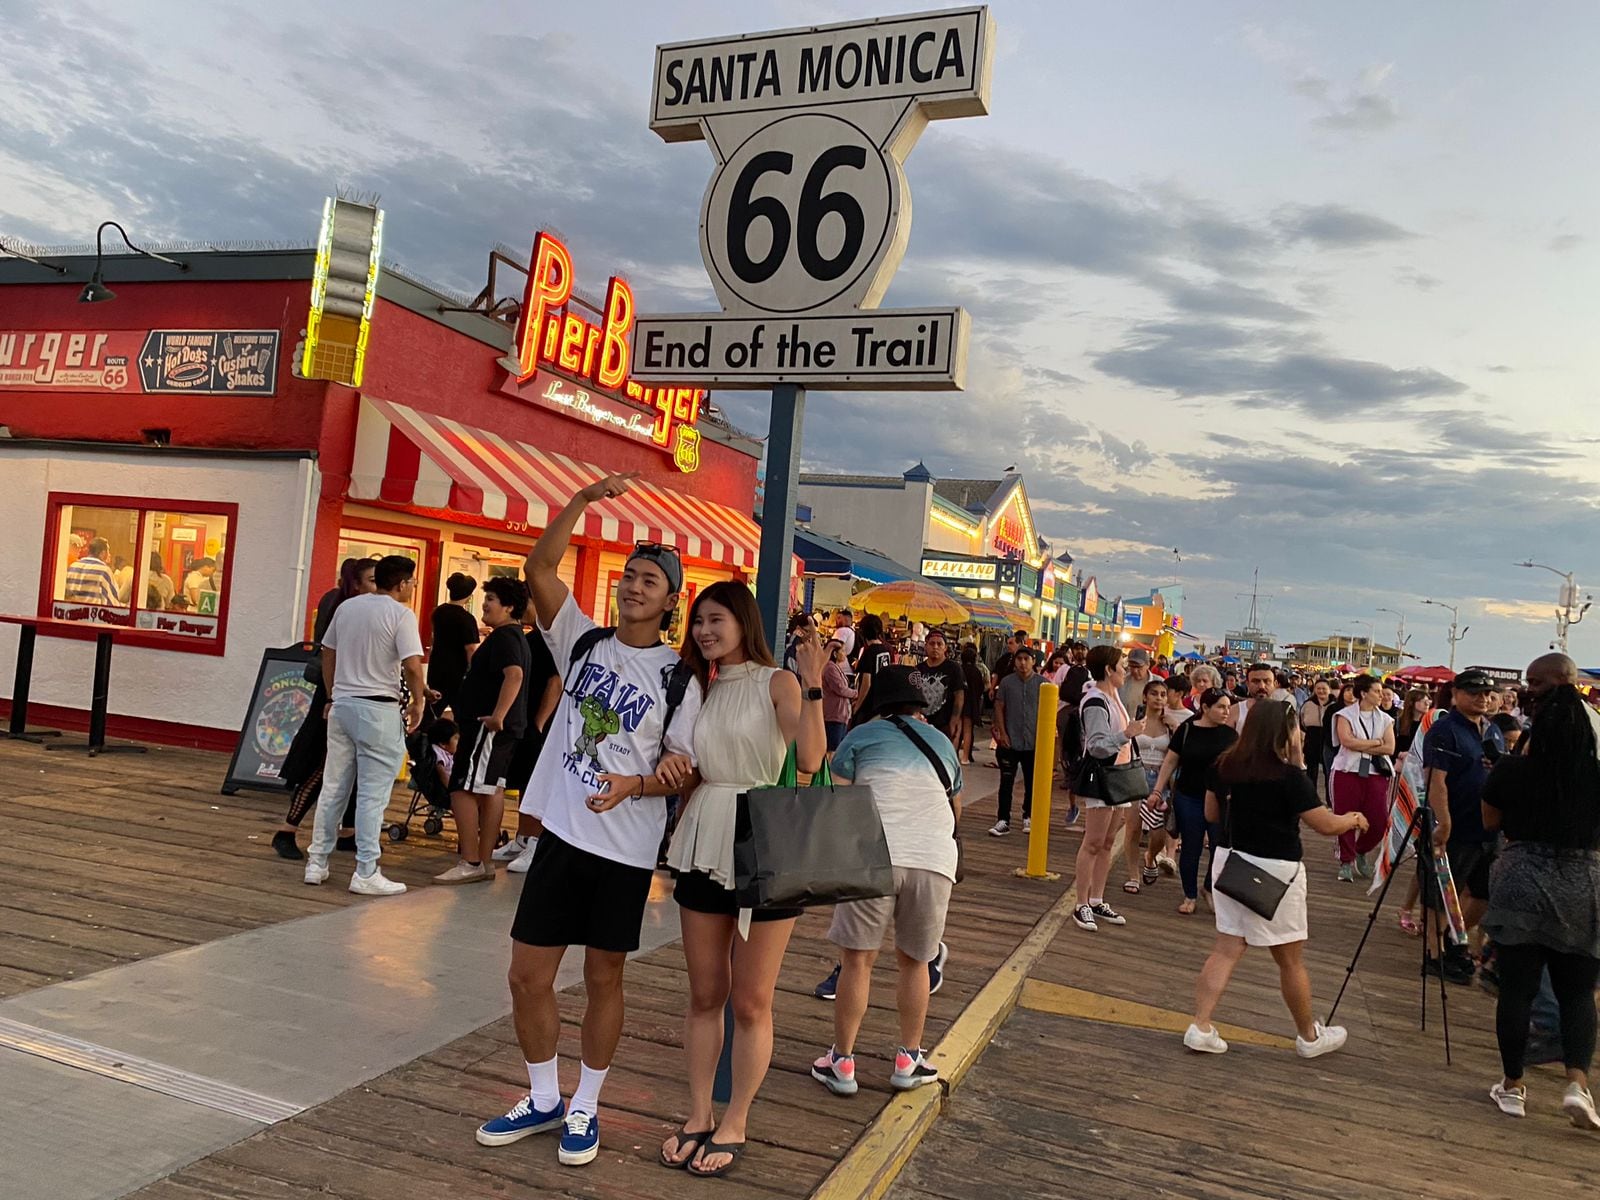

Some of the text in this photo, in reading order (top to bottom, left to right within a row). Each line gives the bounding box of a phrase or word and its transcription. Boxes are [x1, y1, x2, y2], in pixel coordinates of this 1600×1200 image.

[664, 27, 965, 106] SANTA MONICA
[726, 144, 867, 284] 66
[166, 335, 213, 346] WORLD FAMOUS
[233, 335, 274, 345] DELICIOUS TREAT
[644, 320, 939, 368] End of the Trail
[106, 357, 126, 366] ROUTE
[163, 346, 208, 378] Hot Dogs
[218, 350, 258, 378] Custard
[103, 369, 125, 384] 66
[226, 370, 265, 390] Shakes
[680, 443, 696, 465] 66
[924, 561, 995, 575] PLAYLAND
[201, 602, 212, 612] A
[157, 617, 215, 636] Pier Burger
[1480, 669, 1518, 680] PADOG
[608, 742, 632, 757] STEADY
